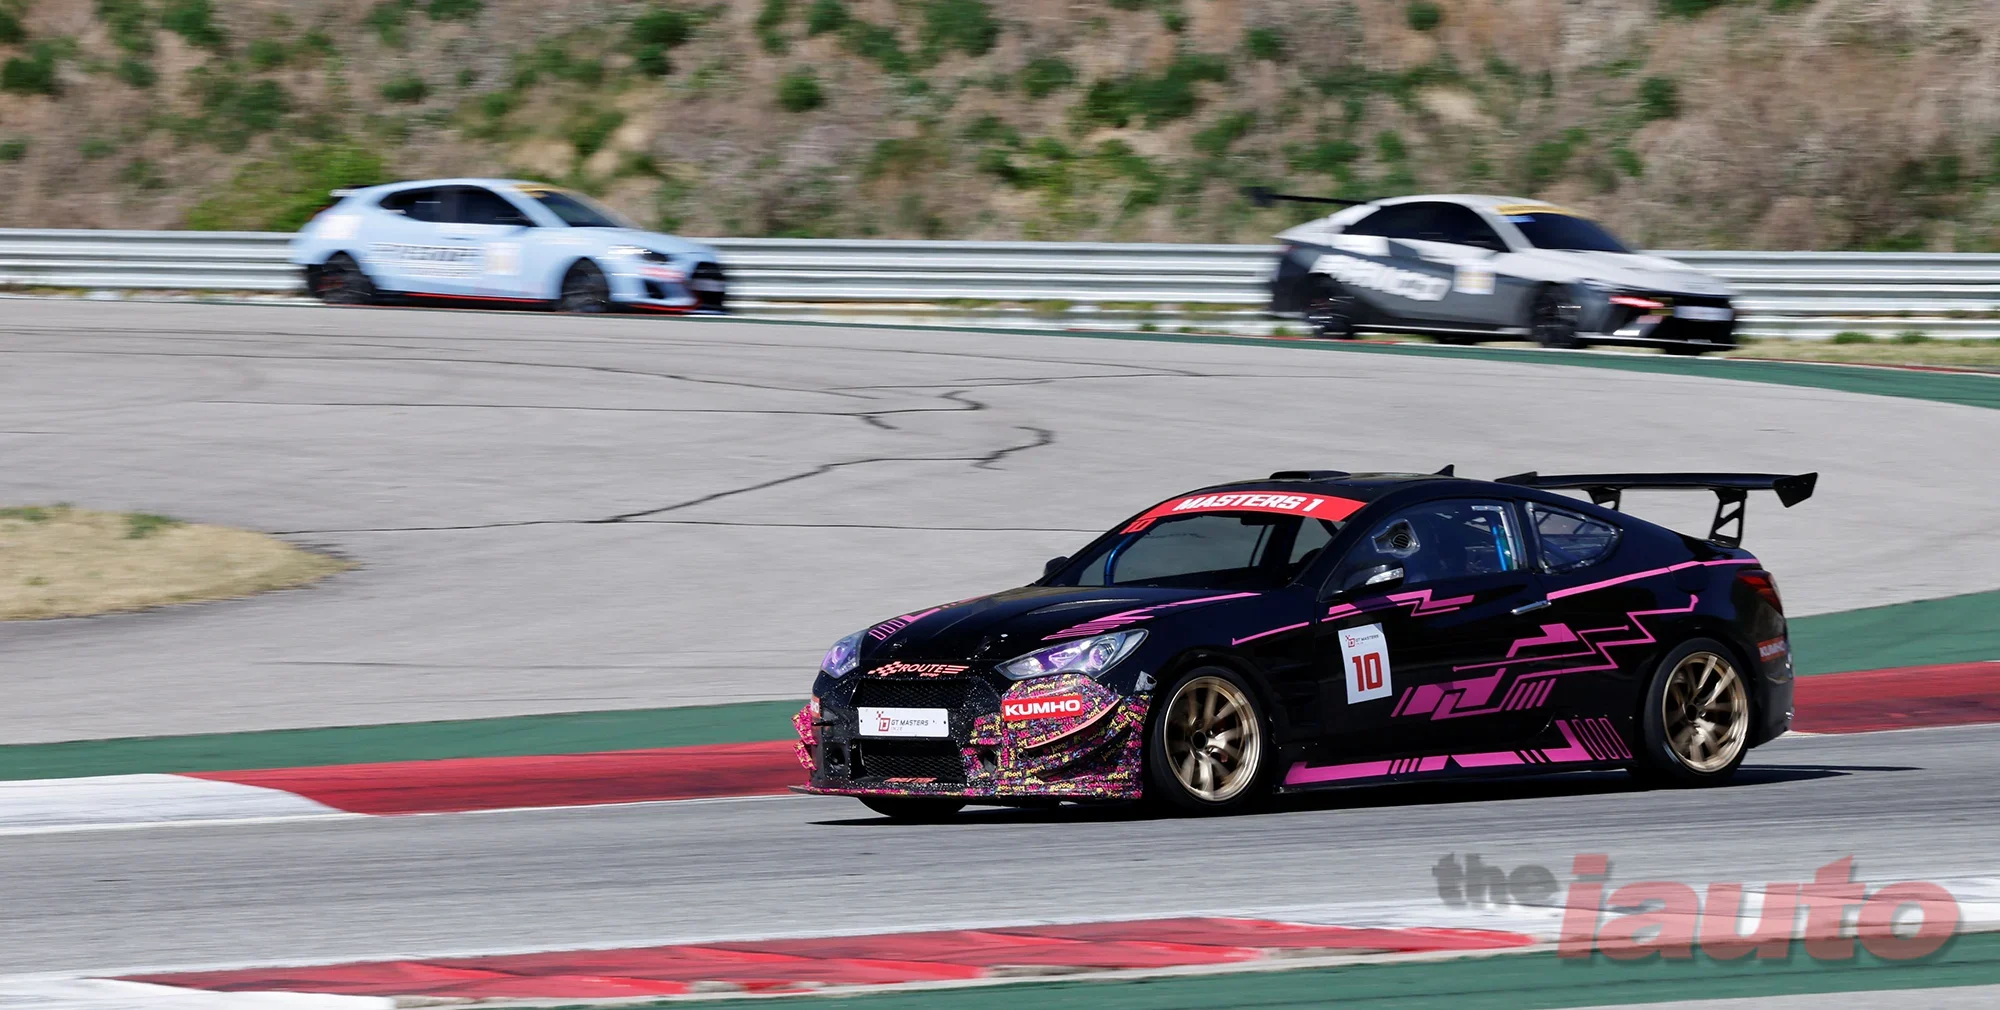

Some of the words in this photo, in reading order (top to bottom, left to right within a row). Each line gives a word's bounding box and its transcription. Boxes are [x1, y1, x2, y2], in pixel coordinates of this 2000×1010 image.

[1171, 494, 1302, 512] MASTERS
[1302, 498, 1325, 513] 1
[1119, 517, 1158, 535] 10
[897, 663, 948, 673] ROUTE
[1352, 652, 1383, 692] 10
[1004, 699, 1081, 717] KUMHO
[900, 719, 929, 727] MASTERS
